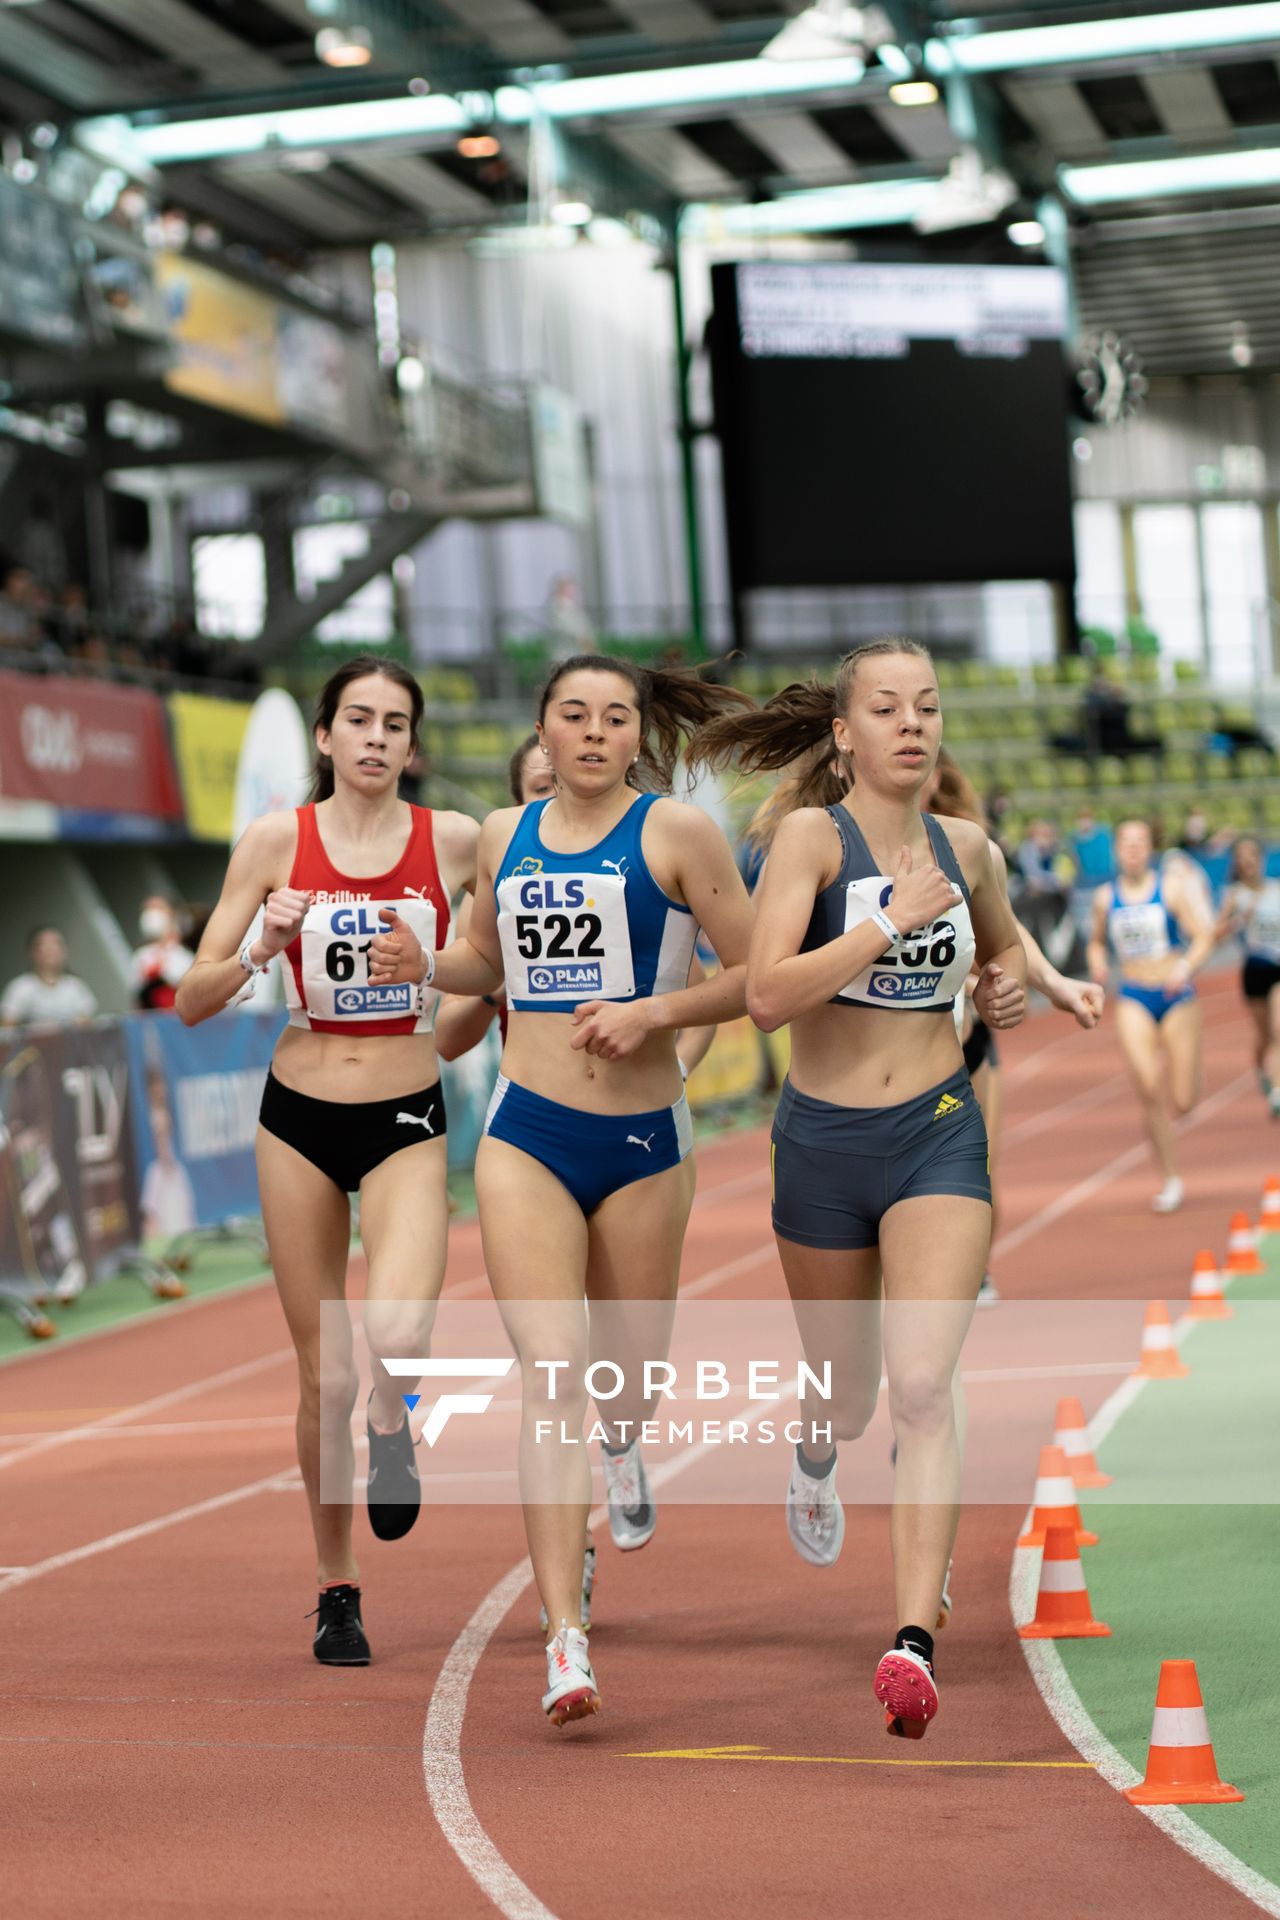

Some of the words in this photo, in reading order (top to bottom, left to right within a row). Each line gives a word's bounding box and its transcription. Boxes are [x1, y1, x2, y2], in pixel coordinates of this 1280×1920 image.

[316, 889, 371, 904] Brillux
[516, 913, 605, 959] 522
[872, 920, 956, 967] 58
[555, 968, 599, 982] PLAN
[904, 976, 938, 990] PLAN
[366, 989, 408, 1003] PLAN
